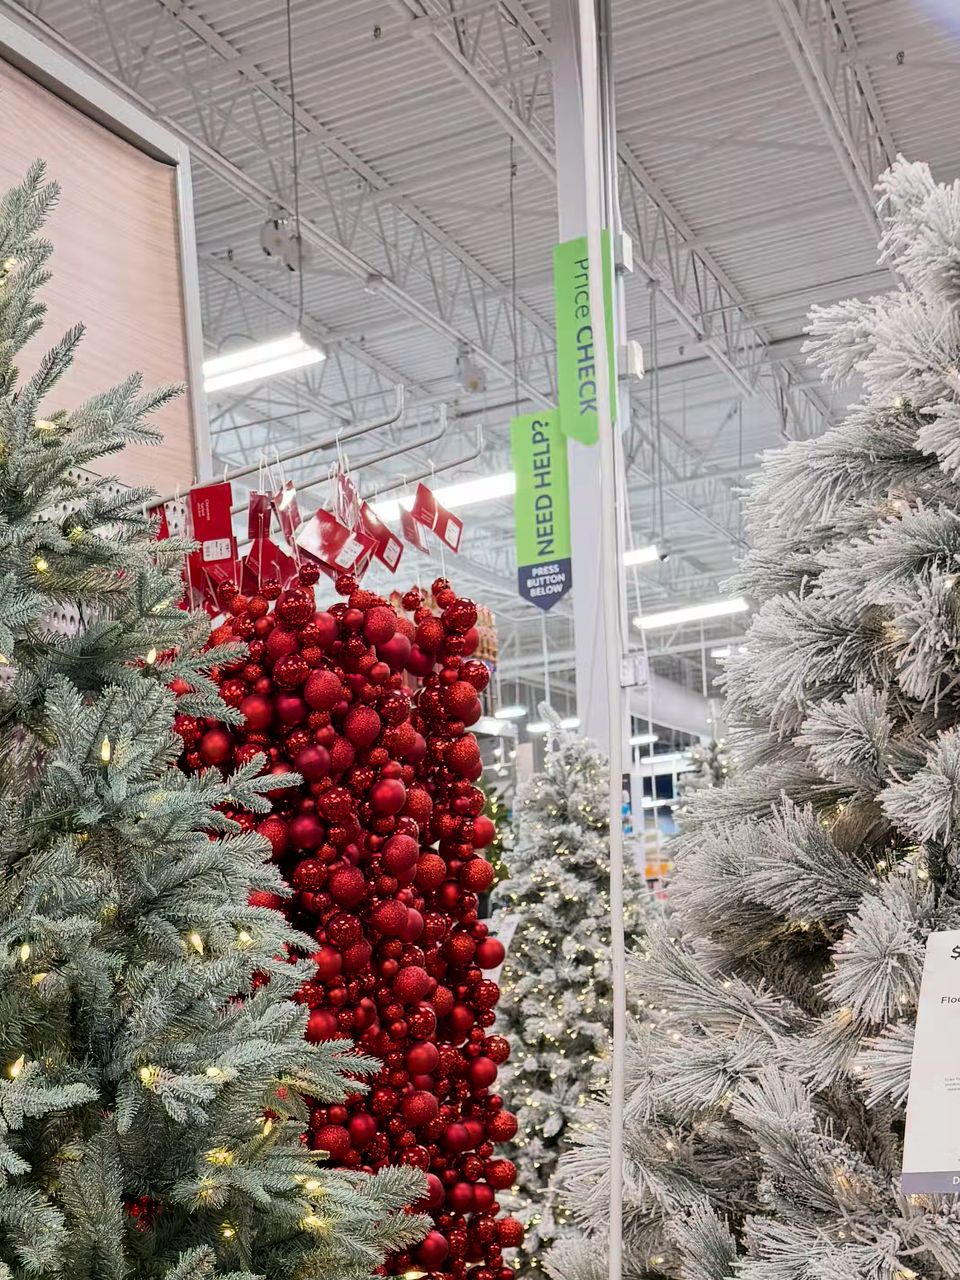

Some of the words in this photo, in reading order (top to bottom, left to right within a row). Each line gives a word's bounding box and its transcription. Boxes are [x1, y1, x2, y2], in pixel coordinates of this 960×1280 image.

[576, 325, 598, 416] CHECK
[531, 419, 552, 489] HELP?
[536, 494, 555, 557] NEED
[526, 572, 566, 588] BUTTON
[530, 582, 564, 597] BELOW
[531, 563, 560, 577] PRESS
